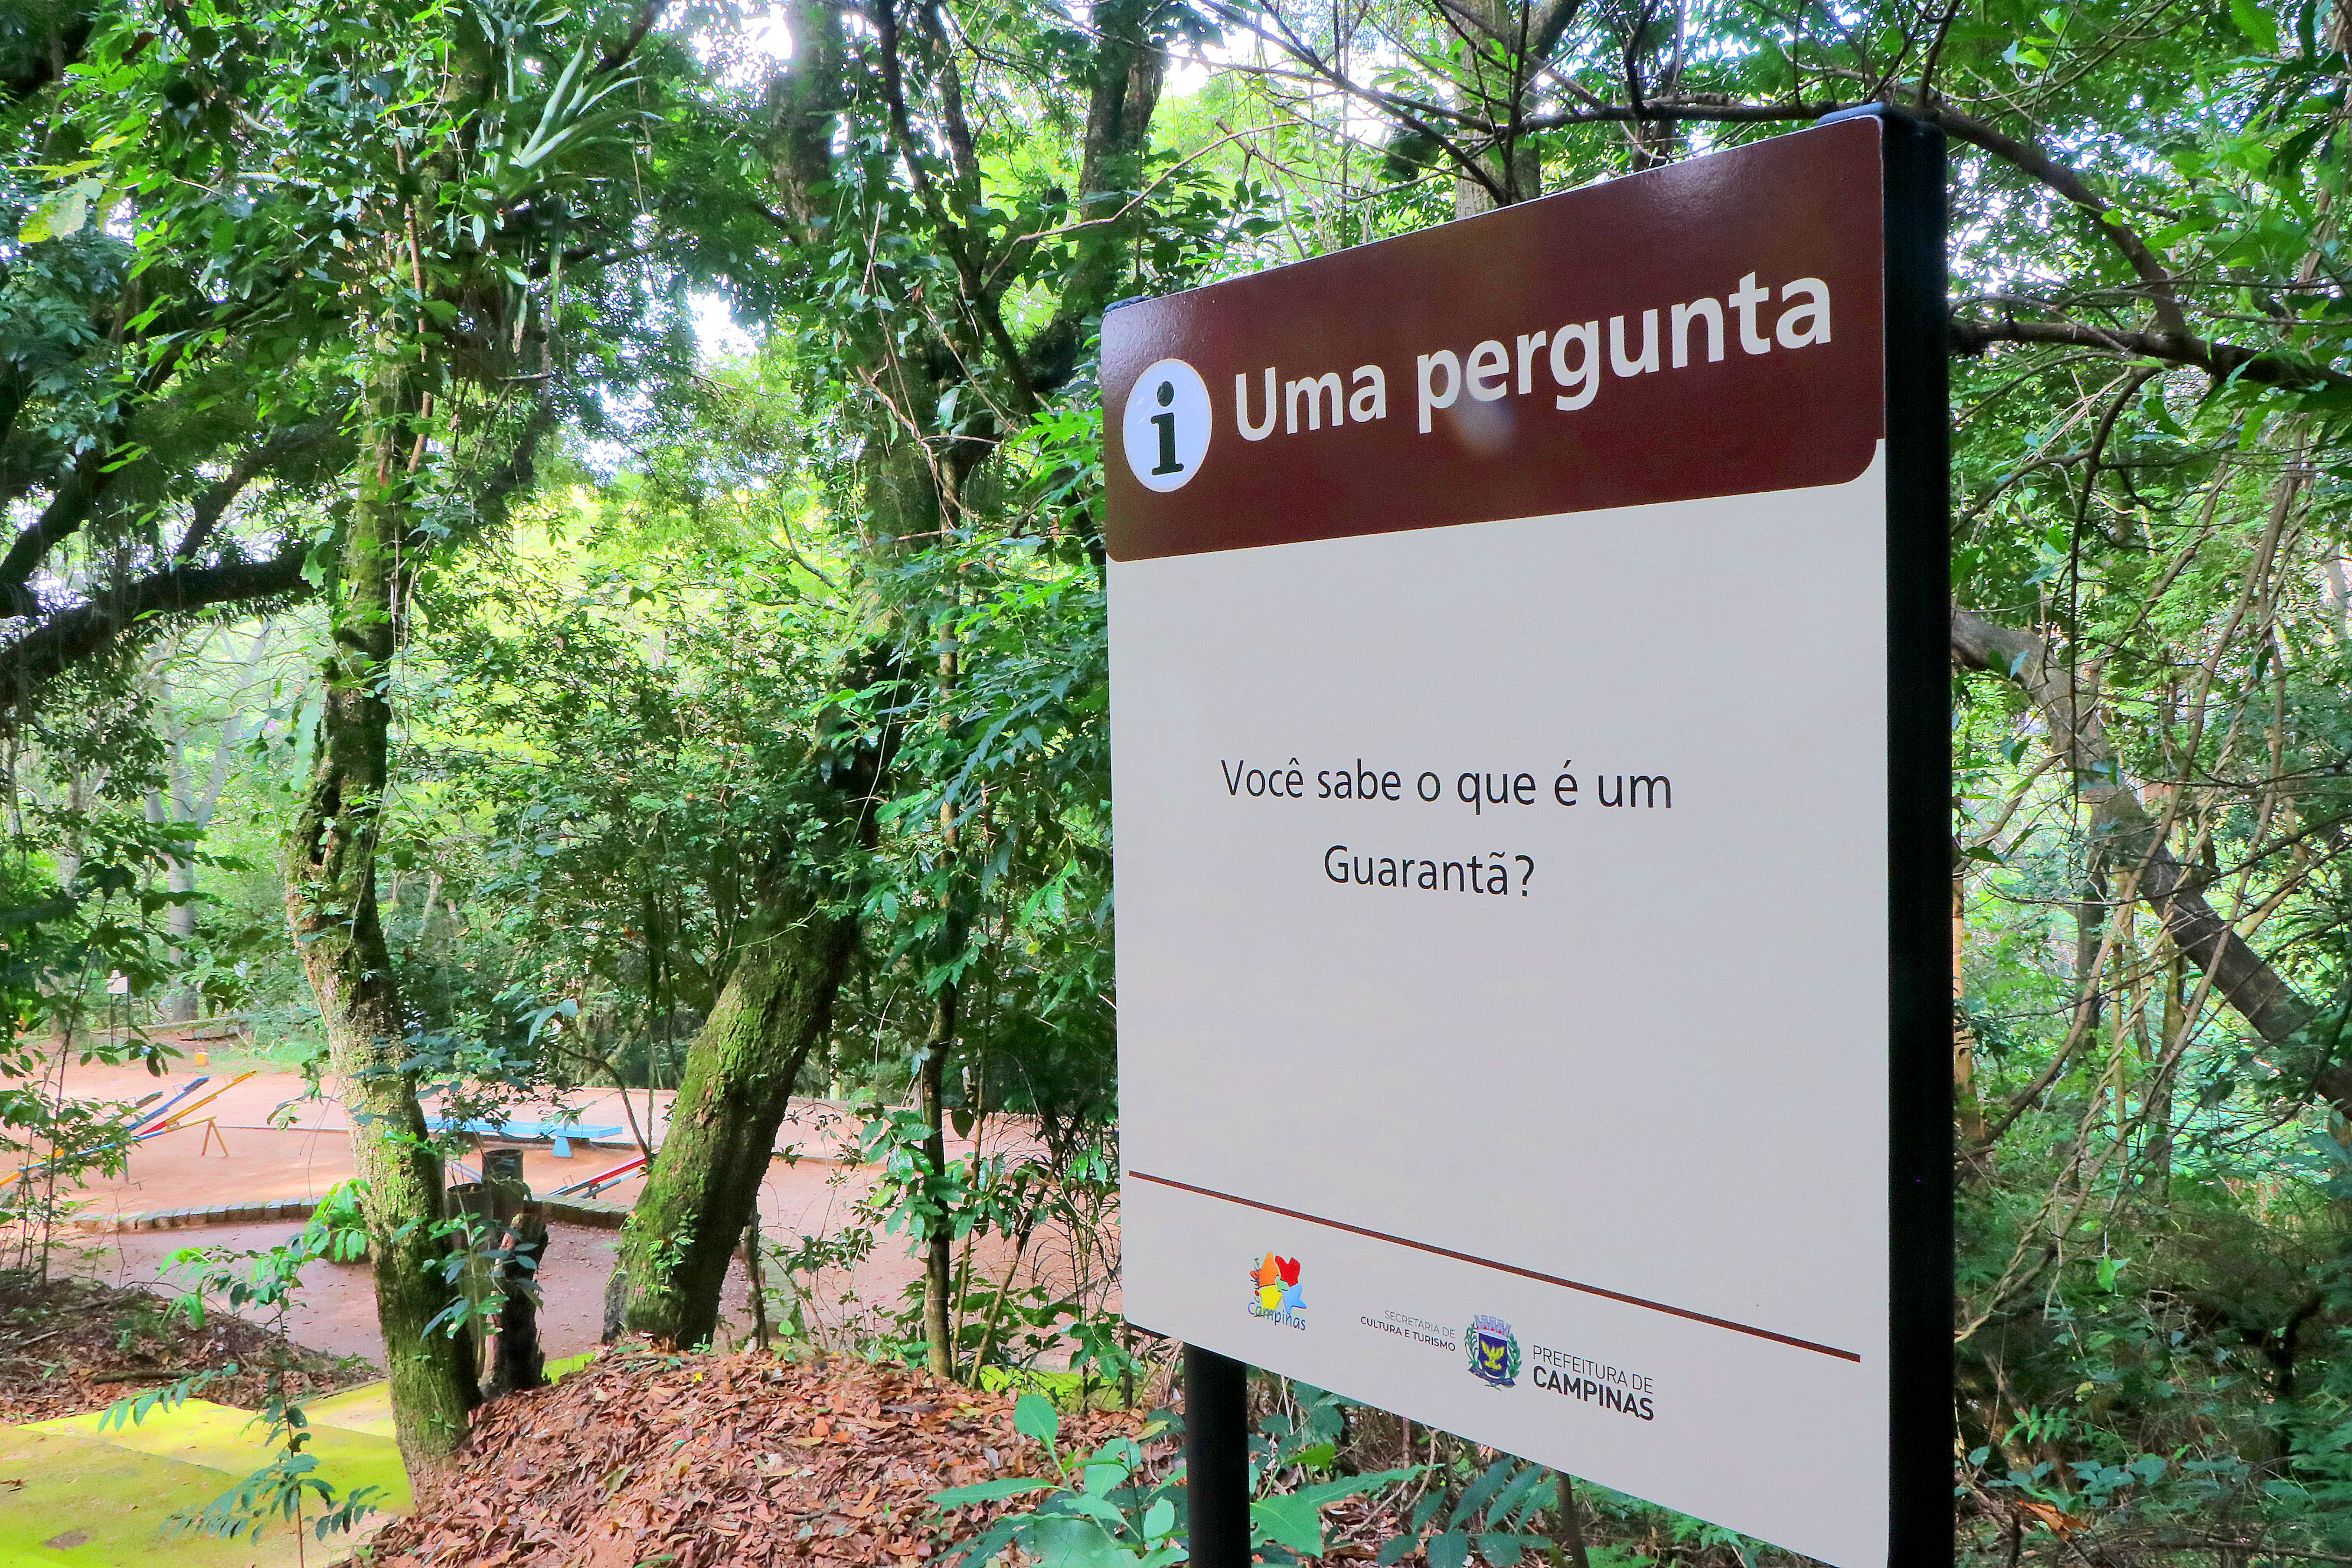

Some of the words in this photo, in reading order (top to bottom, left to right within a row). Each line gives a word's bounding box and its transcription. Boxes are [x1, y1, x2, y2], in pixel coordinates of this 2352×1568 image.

[1234, 364, 1387, 442] Uma
[1416, 270, 1832, 436] pergunta
[1220, 756, 1304, 799] Você
[1317, 757, 1402, 802] sabe
[1416, 771, 1442, 803] o
[1456, 772, 1537, 816] que
[1553, 759, 1579, 807] é
[1598, 774, 1672, 809] um
[1324, 844, 1535, 898] Guarantã?
[1247, 1302, 1306, 1331] Campinas
[1360, 1316, 1403, 1337] CULTURA
[1404, 1328, 1411, 1338] E
[1412, 1331, 1456, 1352] TURISMO
[1384, 1309, 1440, 1335] SECRETARIA
[1442, 1327, 1456, 1339] DE
[1532, 1344, 1629, 1388] PREFEITURA
[1631, 1373, 1654, 1395] DE
[1533, 1365, 1655, 1422] CAMPINAS
